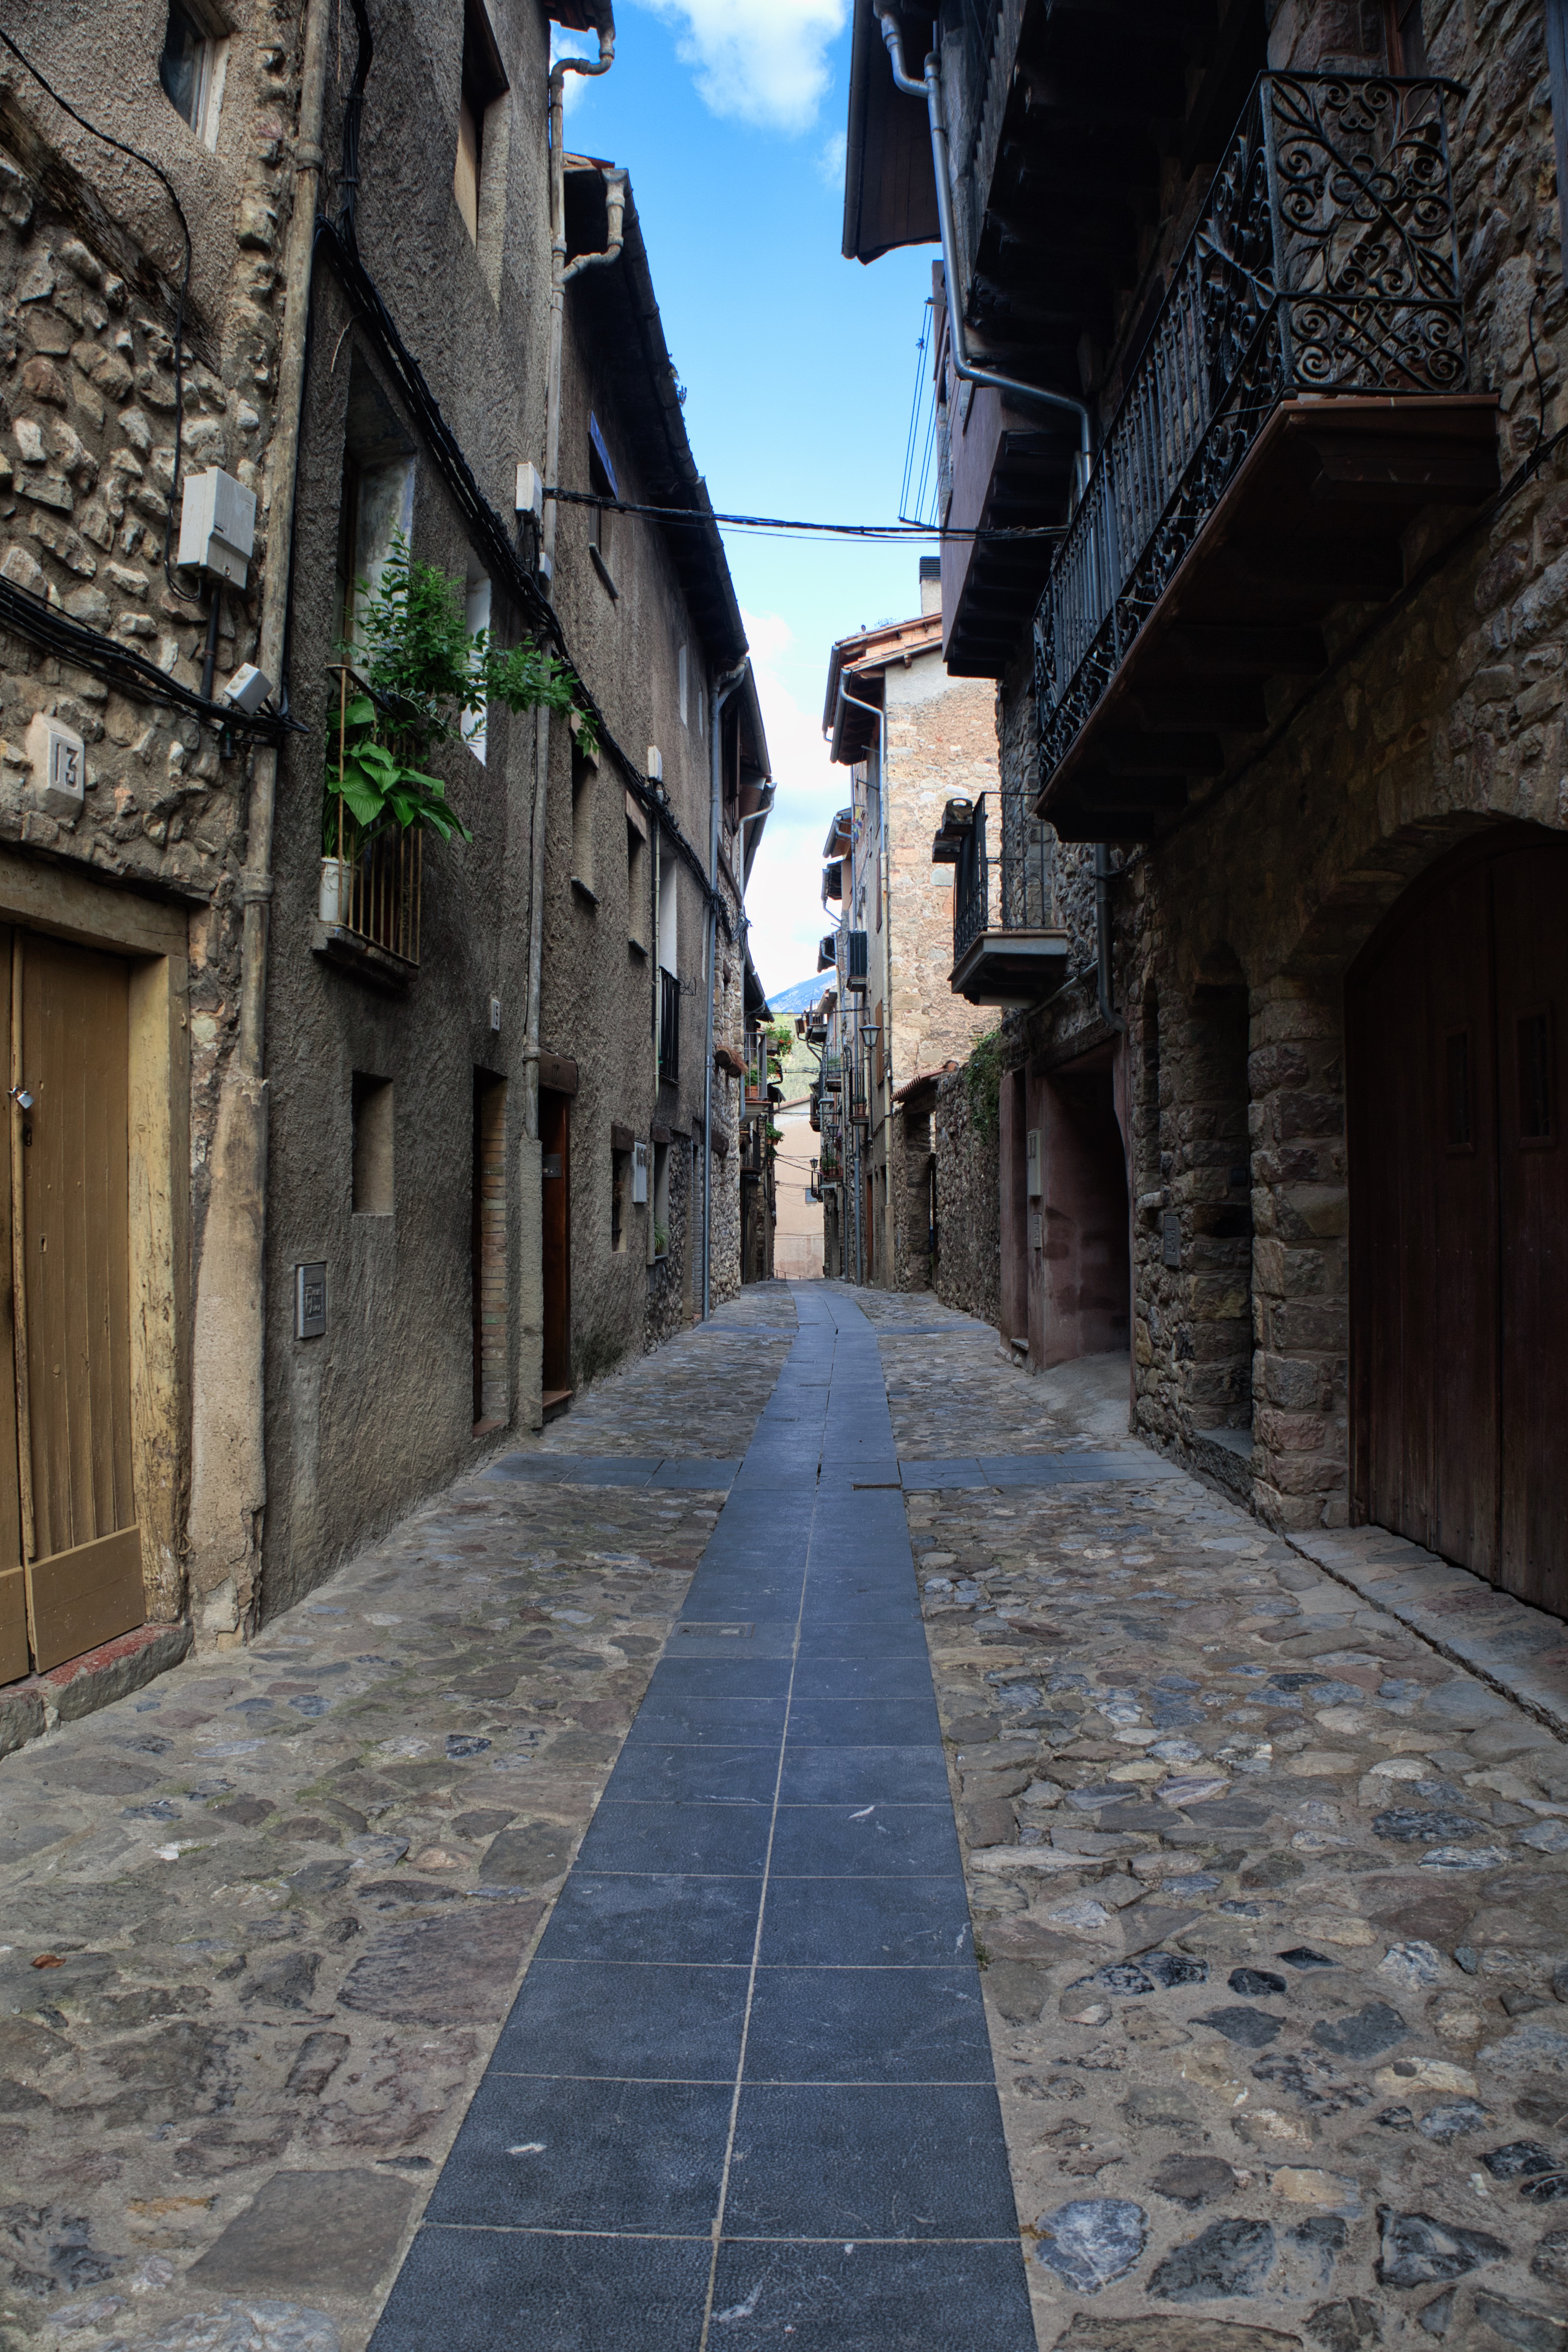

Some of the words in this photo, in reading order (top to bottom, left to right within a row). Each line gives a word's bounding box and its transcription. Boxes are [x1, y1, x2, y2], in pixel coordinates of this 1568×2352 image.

[55, 743, 79, 790] 13
[493, 1004, 499, 1026] 15
[551, 1062, 560, 1085] 17
